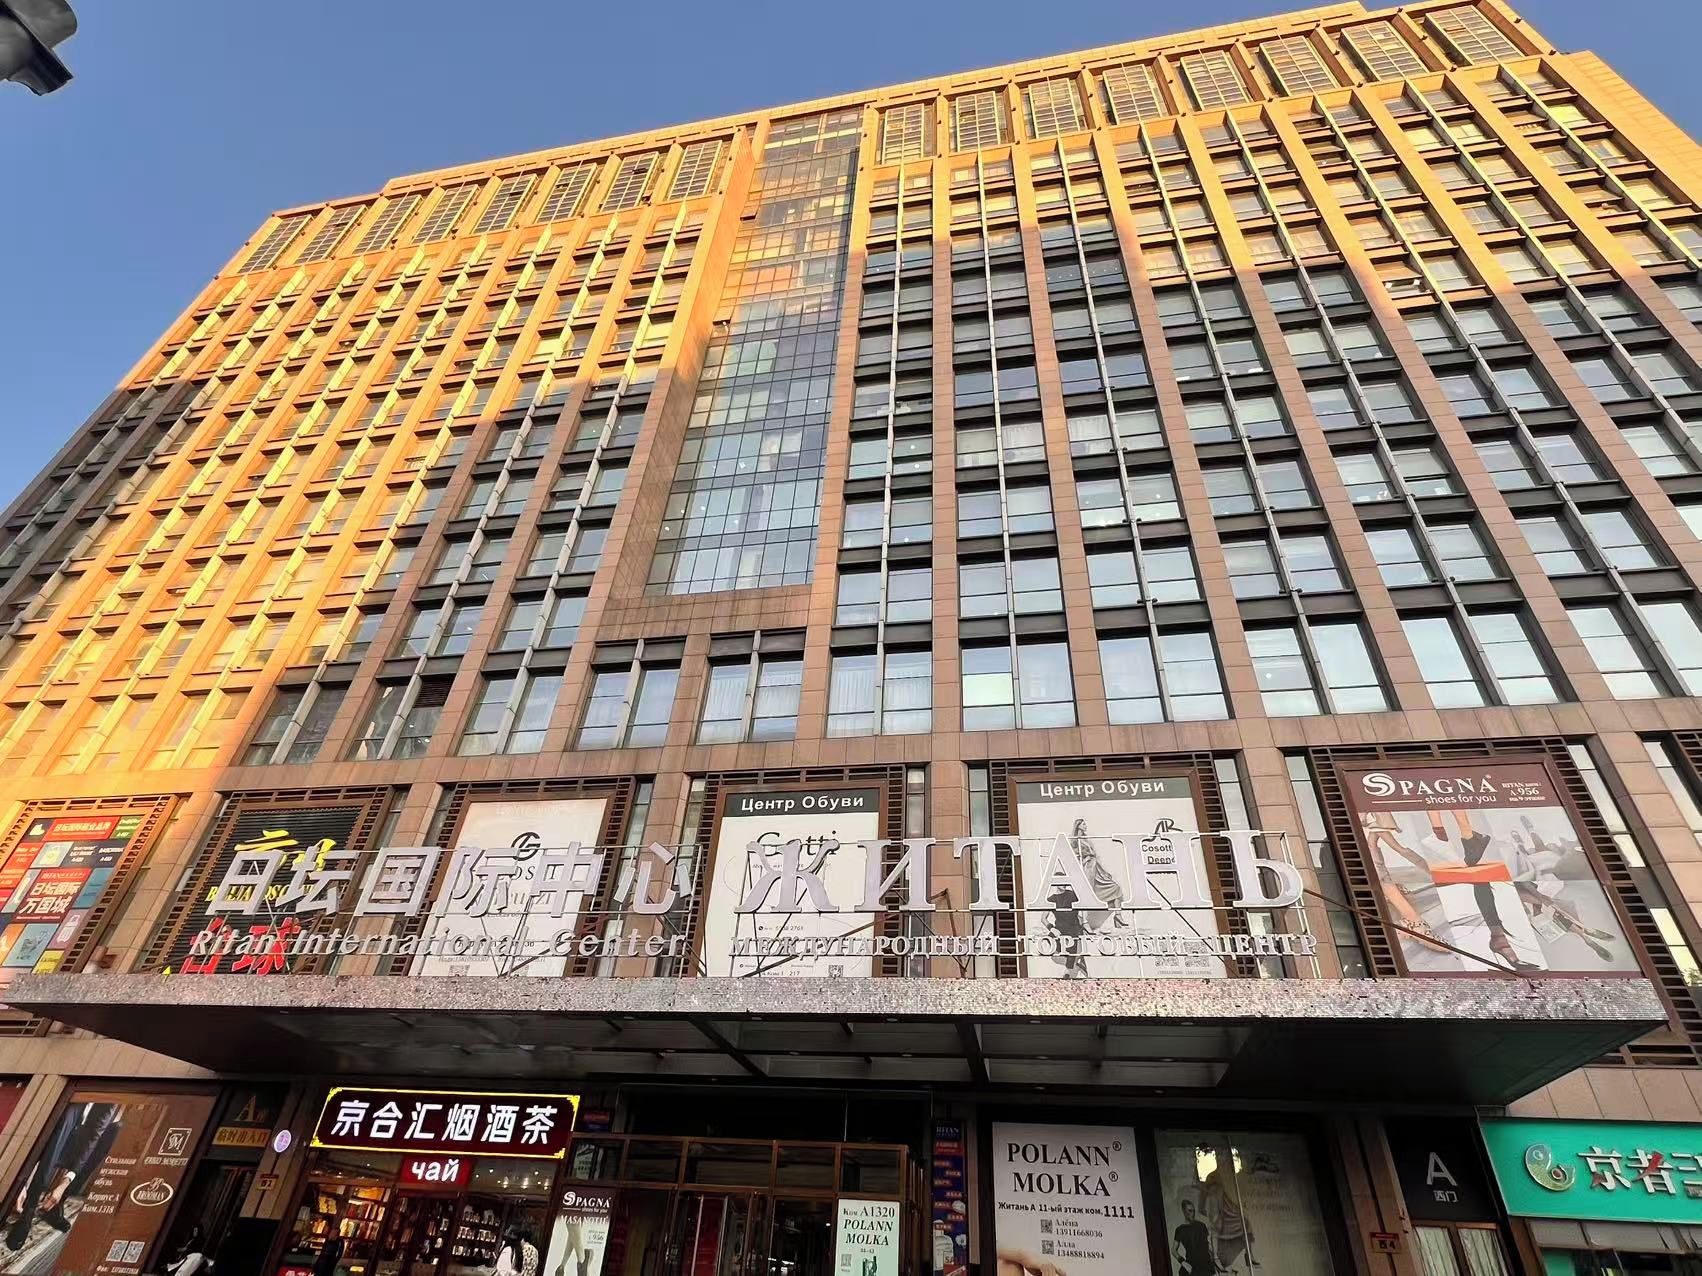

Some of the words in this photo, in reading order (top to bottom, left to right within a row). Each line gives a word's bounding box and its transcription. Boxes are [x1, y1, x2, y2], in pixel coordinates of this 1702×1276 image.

[1040, 782, 1095, 799] Центр
[1101, 780, 1165, 795] Обуви
[1362, 773, 1498, 797] SPAGNA
[741, 798, 795, 812] Центр
[802, 795, 864, 811] Обуви
[1425, 795, 1457, 805] shoes
[1458, 794, 1474, 803] for
[1475, 795, 1497, 805] you
[204, 841, 693, 918] 日坛国际中心
[734, 829, 1304, 914] ЖИТАНЬ
[30, 882, 82, 896] 日坛国际
[19, 896, 73, 914] 万国城
[188, 929, 276, 956] Ritan
[291, 927, 529, 957] International
[551, 928, 688, 957] Center
[729, 934, 999, 961] МЕЖДУНАРОДНЫЙ
[1021, 931, 1187, 957] ТОРГОВЫЙ
[1206, 933, 1317, 960] ЦЕНТР
[330, 1099, 558, 1145] 京合汇烟酒茶
[1007, 1143, 1110, 1167] POLANN
[410, 1158, 461, 1183] чай
[1426, 1151, 1459, 1187] A
[1013, 1172, 1111, 1197] MOLKA
[563, 1191, 610, 1208] SPAGNA
[998, 1201, 1029, 1211] Житань
[1063, 1206, 1084, 1214] этаж
[843, 1218, 894, 1231] POLANN
[845, 1233, 889, 1246] MOLKA
